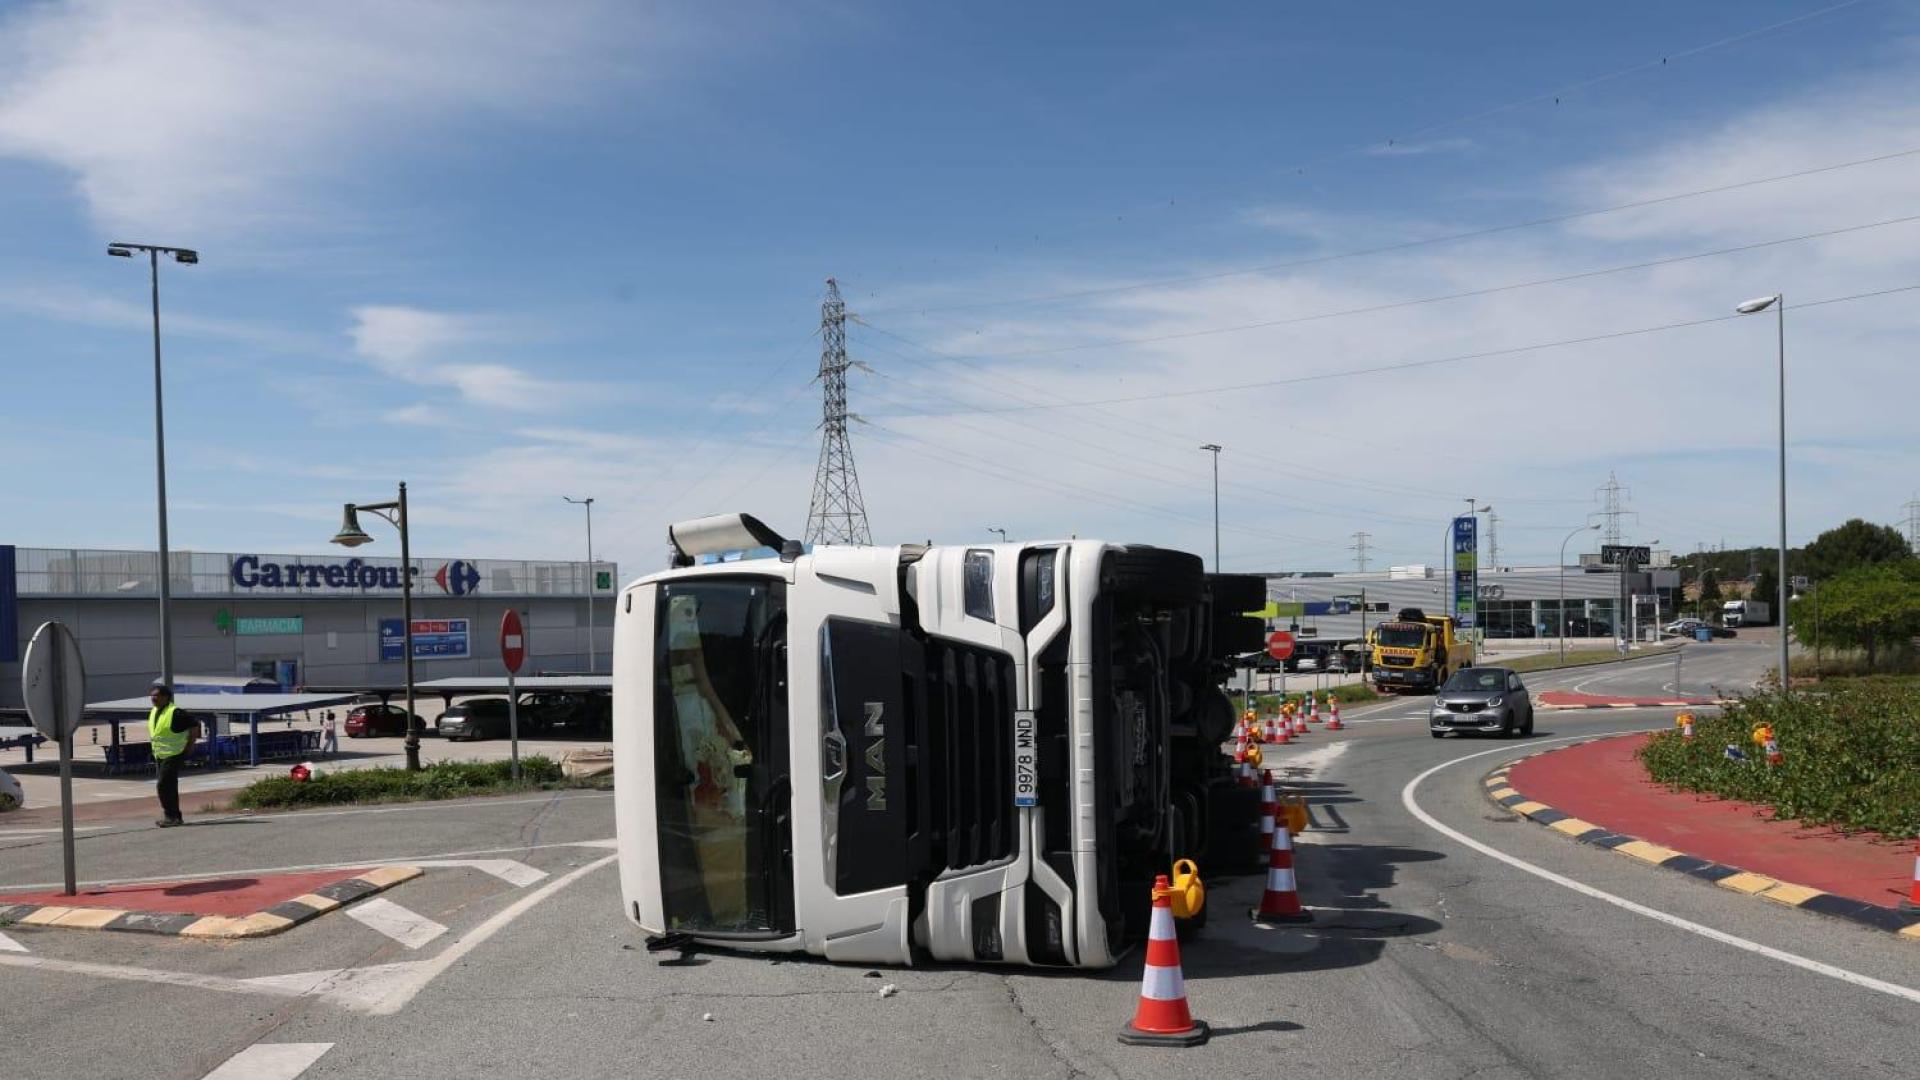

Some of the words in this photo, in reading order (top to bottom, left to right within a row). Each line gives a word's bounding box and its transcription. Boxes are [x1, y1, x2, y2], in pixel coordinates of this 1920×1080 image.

[232, 556, 418, 588] Carrefour
[1017, 718, 1033, 748] MND
[864, 702, 887, 811] MAN
[1018, 754, 1034, 794] 9978
